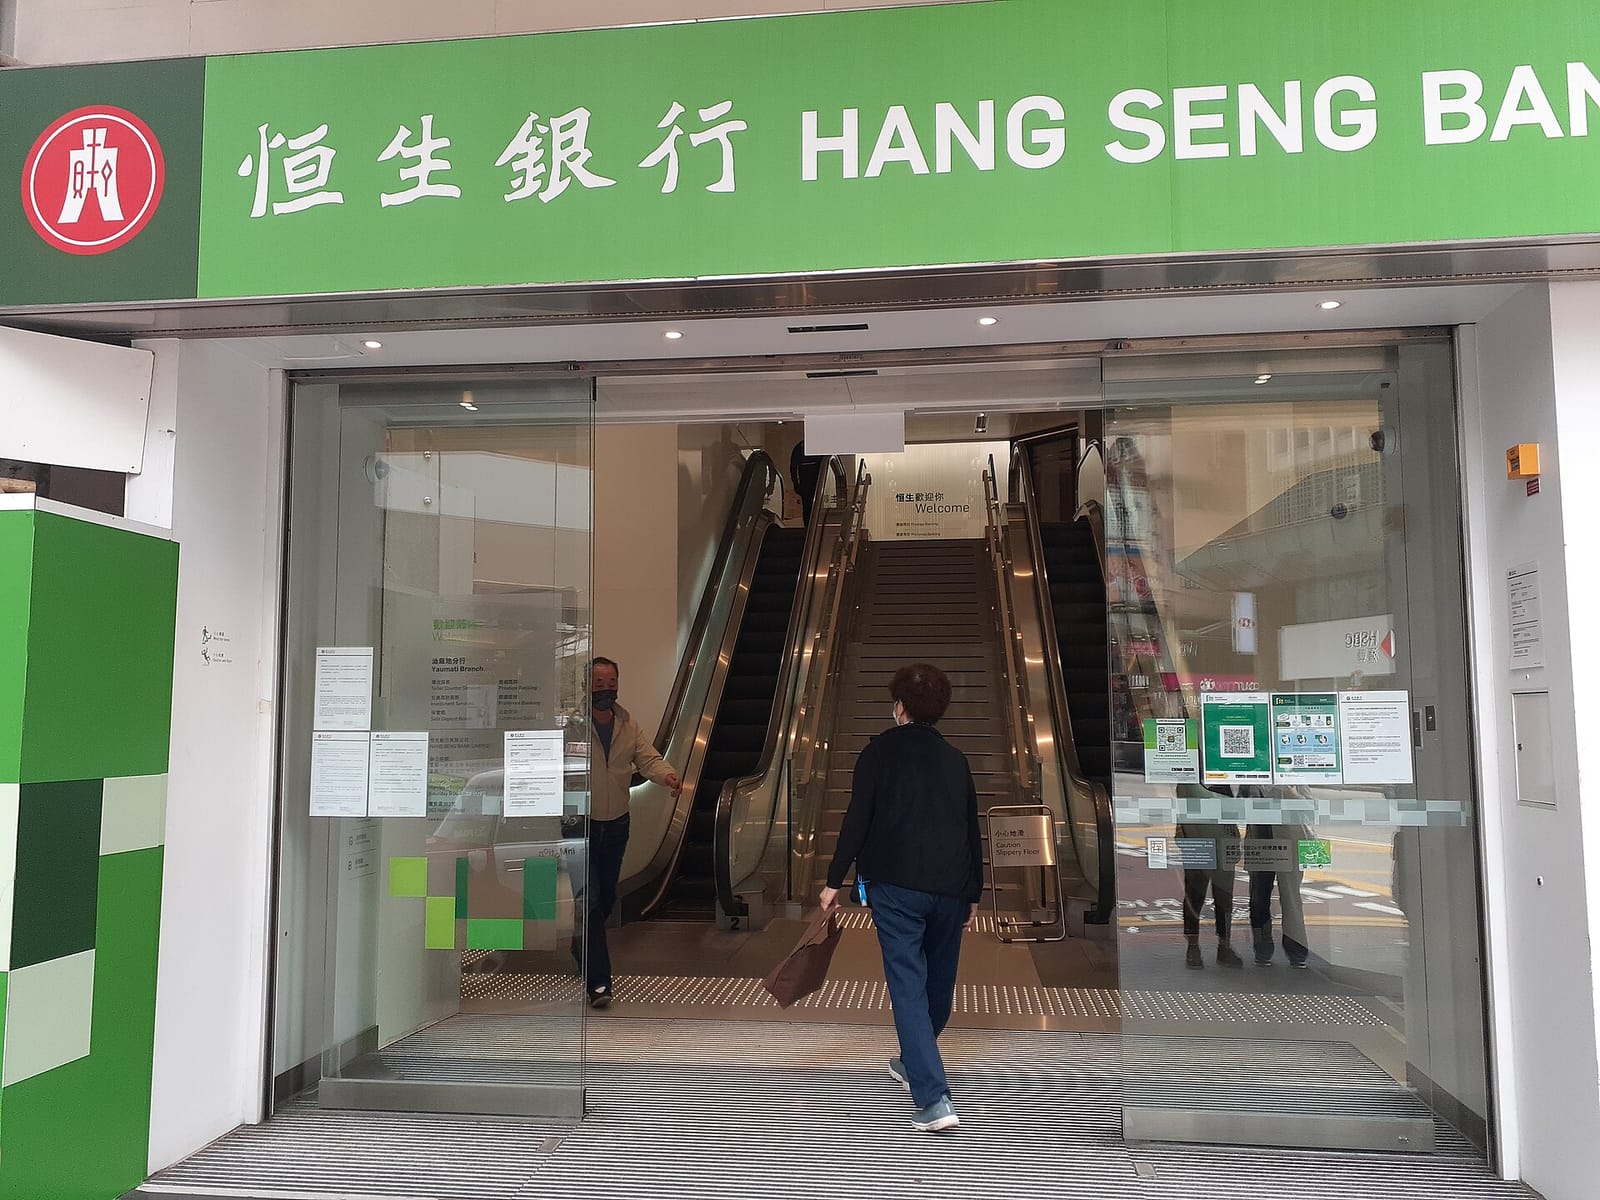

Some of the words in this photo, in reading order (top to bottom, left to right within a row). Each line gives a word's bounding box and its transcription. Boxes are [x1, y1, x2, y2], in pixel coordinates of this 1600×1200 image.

[801, 94, 1067, 182] HANG
[1104, 74, 1379, 164] SENG
[236, 100, 749, 219] 恒生銀行
[915, 503, 970, 514] Welcome
[460, 665, 484, 673] Branch
[996, 849, 1022, 857] Slippery
[1023, 848, 1041, 856] Floor
[731, 917, 740, 930] 2
